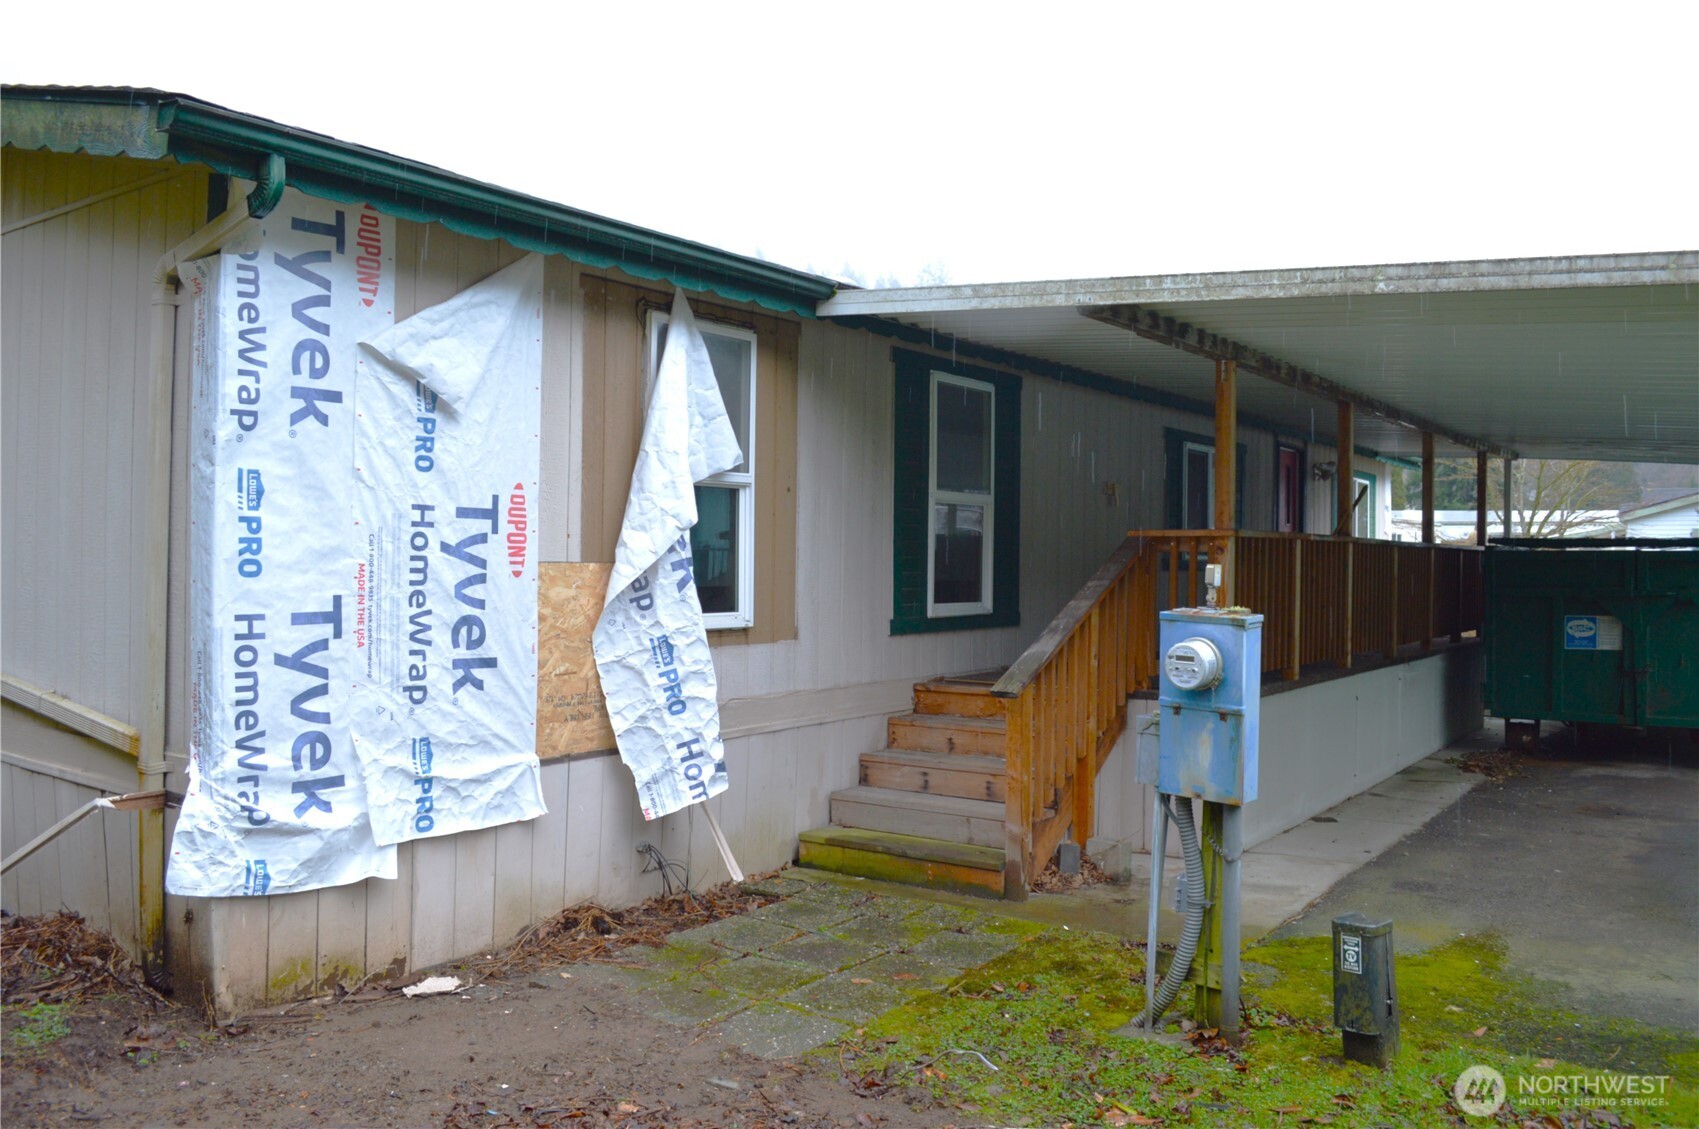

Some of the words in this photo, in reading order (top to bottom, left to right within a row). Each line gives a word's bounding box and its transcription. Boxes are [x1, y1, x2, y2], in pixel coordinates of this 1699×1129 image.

[356, 213, 382, 297] DUPONT
[229, 230, 268, 432] meWrap
[274, 209, 346, 428] Tyvek
[414, 416, 437, 473] PRO
[248, 473, 259, 507] LOWE'S
[238, 515, 263, 578] PRO
[506, 493, 528, 568] DUPONT
[357, 563, 366, 591] MADE
[357, 594, 365, 605] IN
[402, 503, 435, 706] HomeWrap
[440, 494, 499, 693] Tyvek
[356, 608, 365, 626] THE
[356, 628, 365, 648] USA
[274, 594, 346, 819] Tyvek
[658, 668, 687, 716] PRO
[414, 777, 435, 833] PRO
